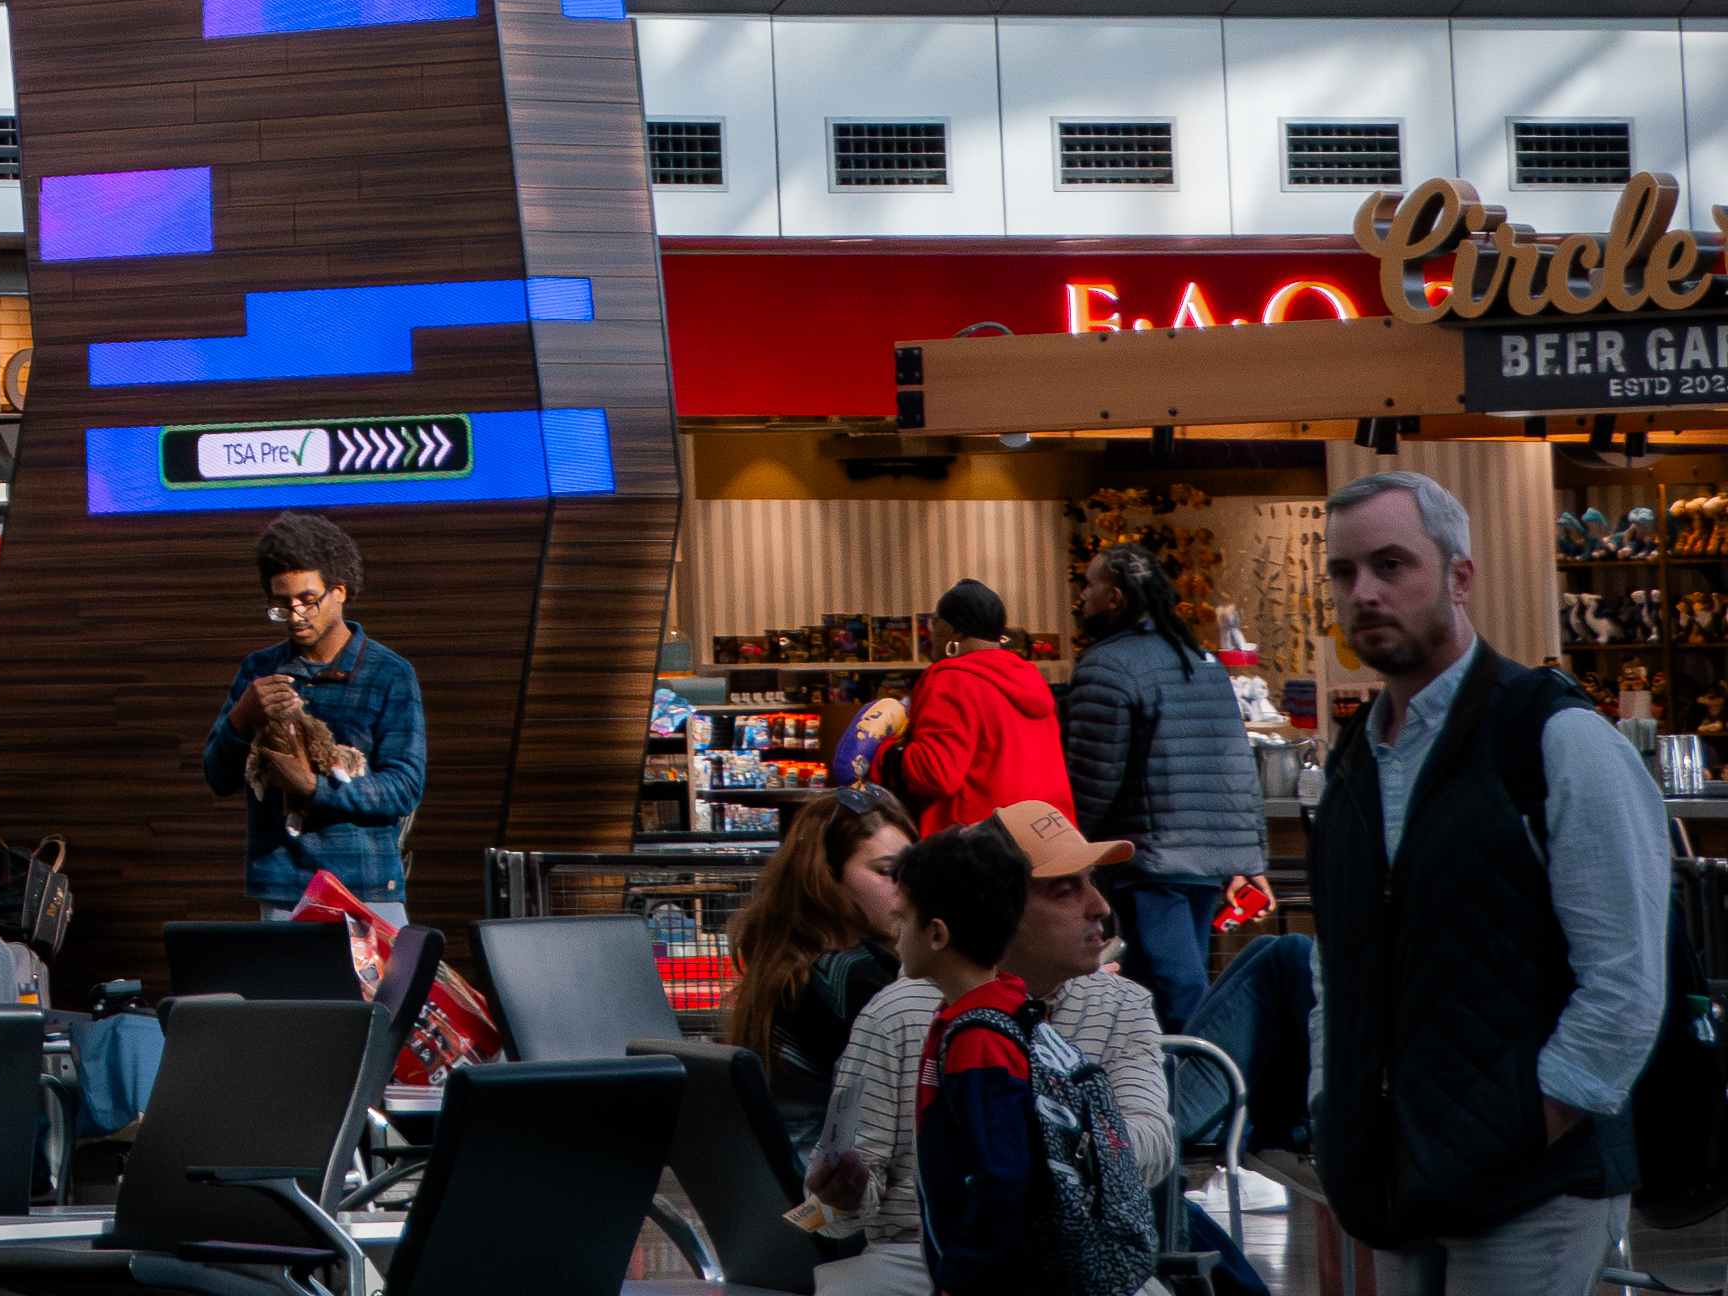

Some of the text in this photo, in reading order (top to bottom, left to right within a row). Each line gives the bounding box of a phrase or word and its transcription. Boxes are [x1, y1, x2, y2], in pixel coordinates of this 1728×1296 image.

[1353, 171, 1712, 325] Circle
[1501, 330, 1626, 378] BEER
[1609, 374, 1728, 397] ESTD 202
[223, 443, 257, 465] TSA
